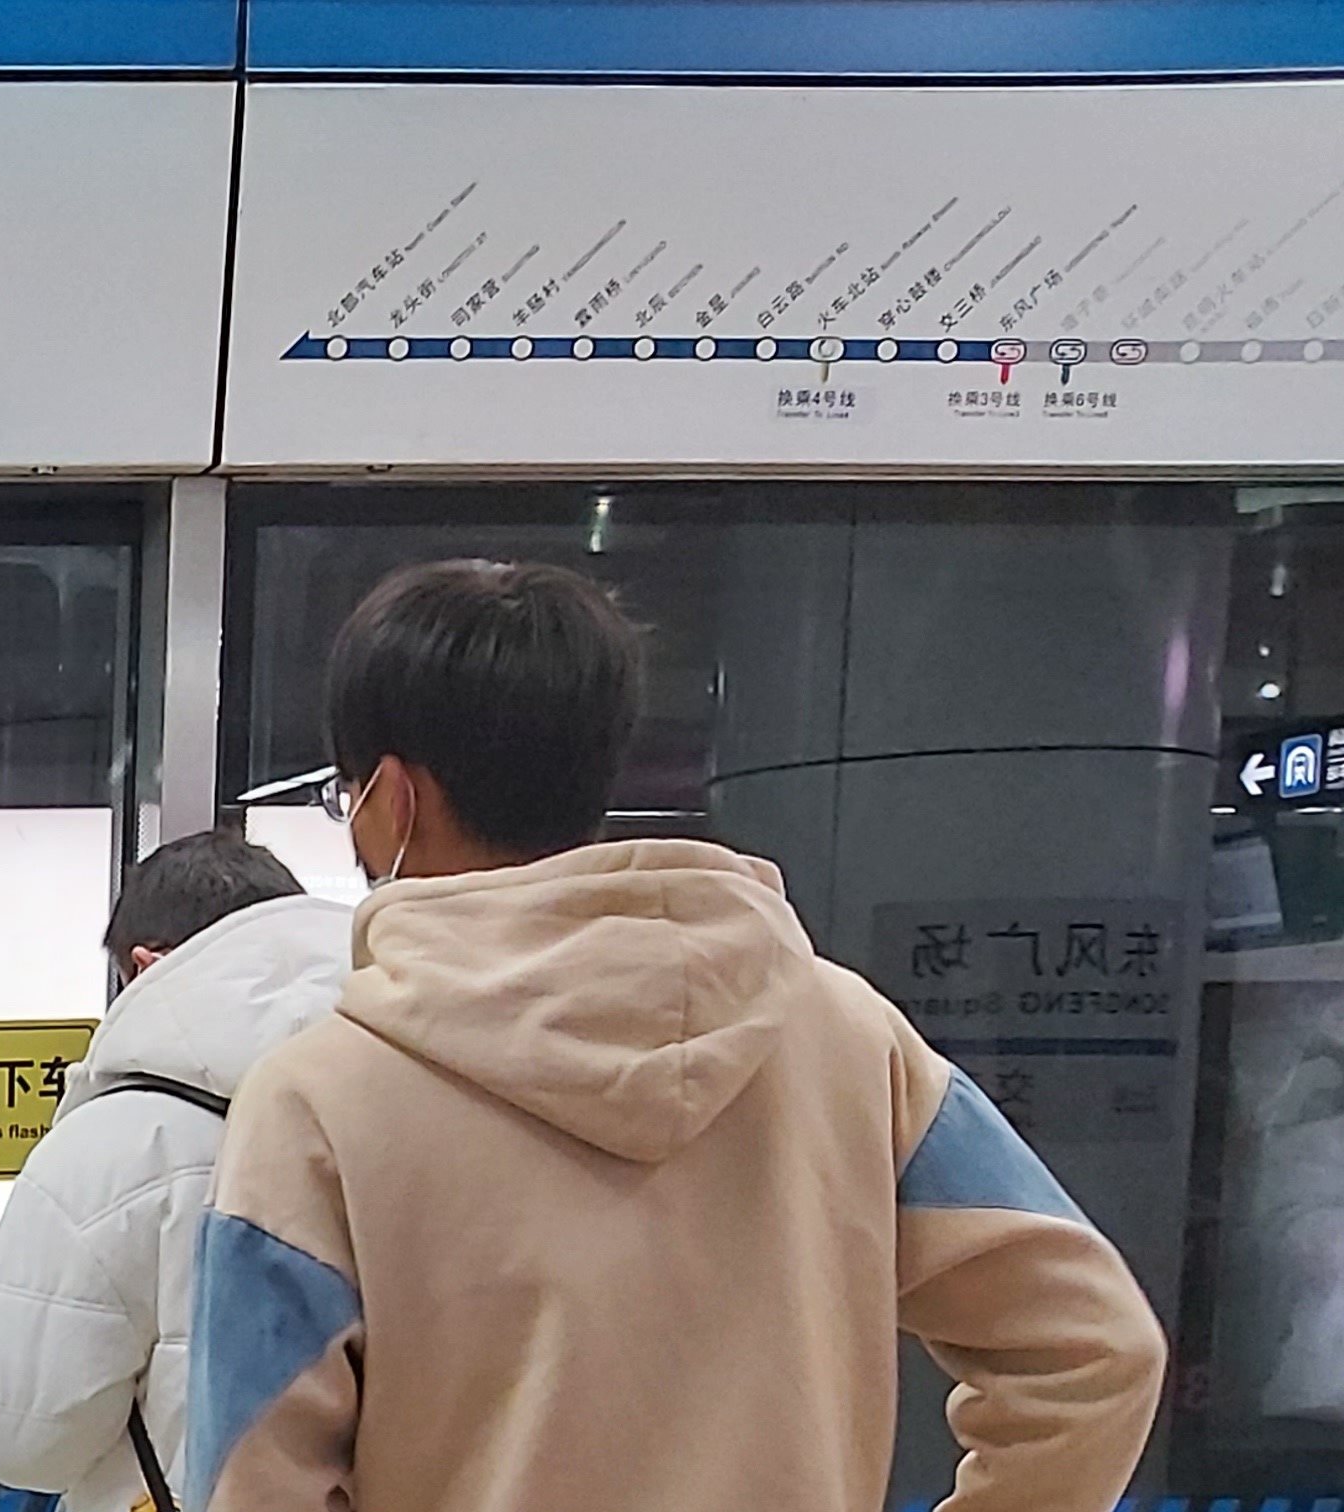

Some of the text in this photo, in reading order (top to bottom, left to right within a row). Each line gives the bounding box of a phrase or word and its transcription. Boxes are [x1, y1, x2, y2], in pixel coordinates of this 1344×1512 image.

[695, 293, 729, 328] 金星
[757, 280, 805, 329] 白云路
[817, 266, 880, 330] 火车北站
[939, 283, 986, 333] 交三桥
[1000, 268, 1063, 332] 东风广场
[8, 1124, 53, 1140] flash
